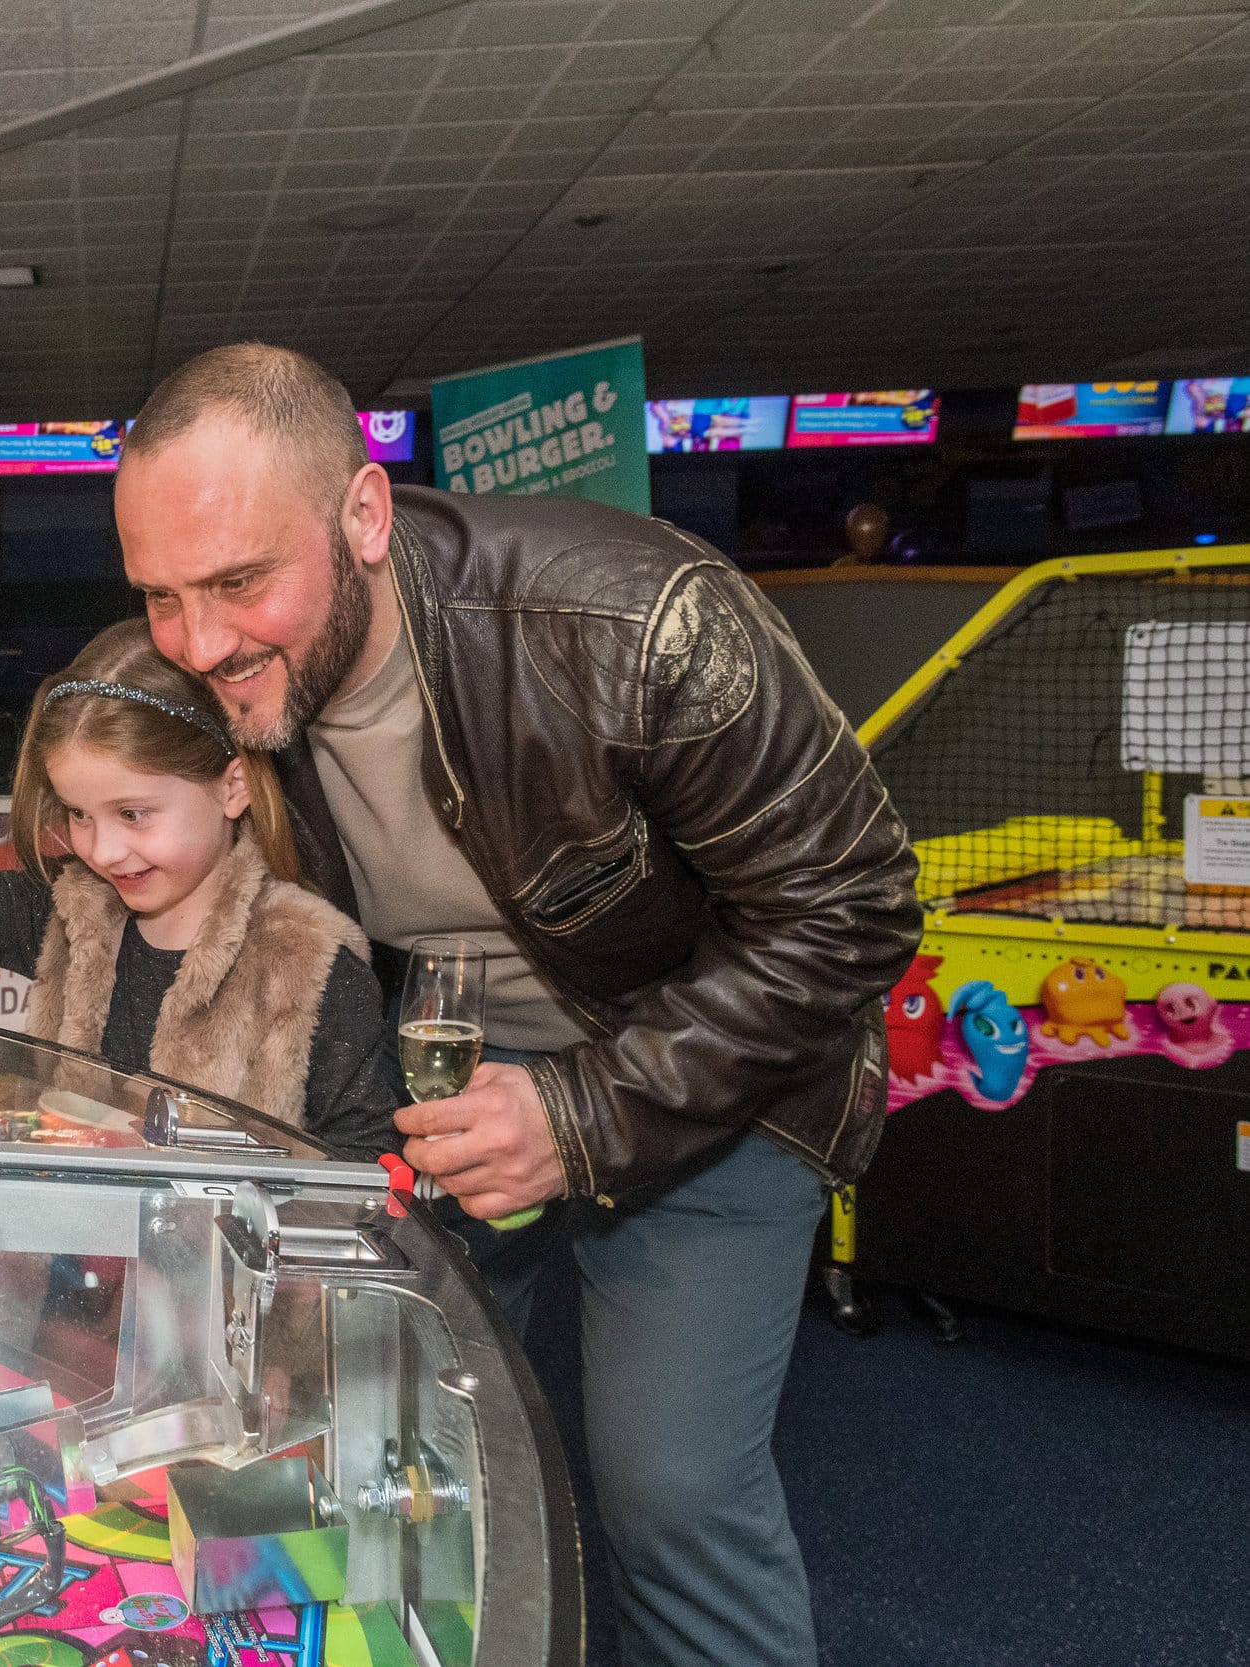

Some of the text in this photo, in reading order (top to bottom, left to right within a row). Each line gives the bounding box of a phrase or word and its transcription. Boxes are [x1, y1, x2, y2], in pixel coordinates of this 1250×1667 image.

[443, 391, 588, 473] BOWLING
[592, 381, 618, 413] &
[451, 422, 614, 494] A BURGER.
